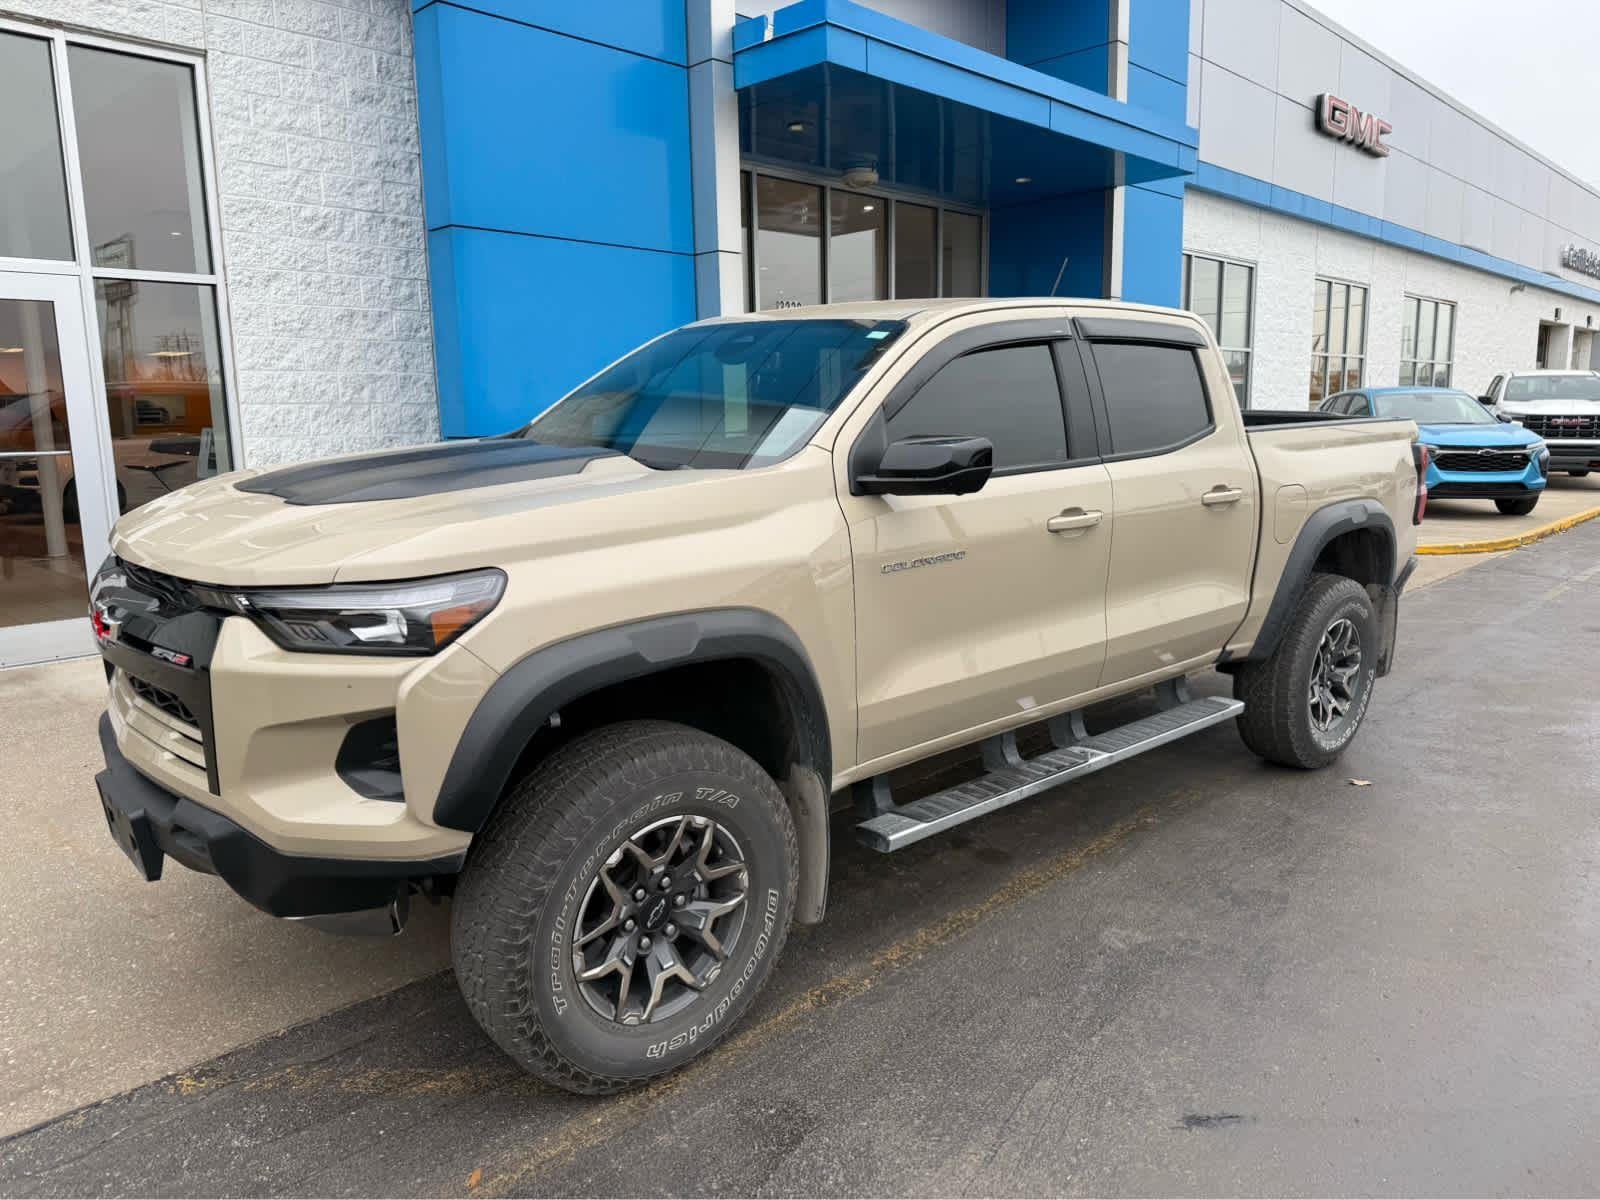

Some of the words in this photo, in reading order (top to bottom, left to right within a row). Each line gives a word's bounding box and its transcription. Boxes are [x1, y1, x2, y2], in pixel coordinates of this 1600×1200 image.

[1315, 92, 1392, 158] GMC
[880, 551, 966, 574] COLORADO
[695, 787, 740, 809] T/A
[647, 888, 779, 1059] BFGoodrich
